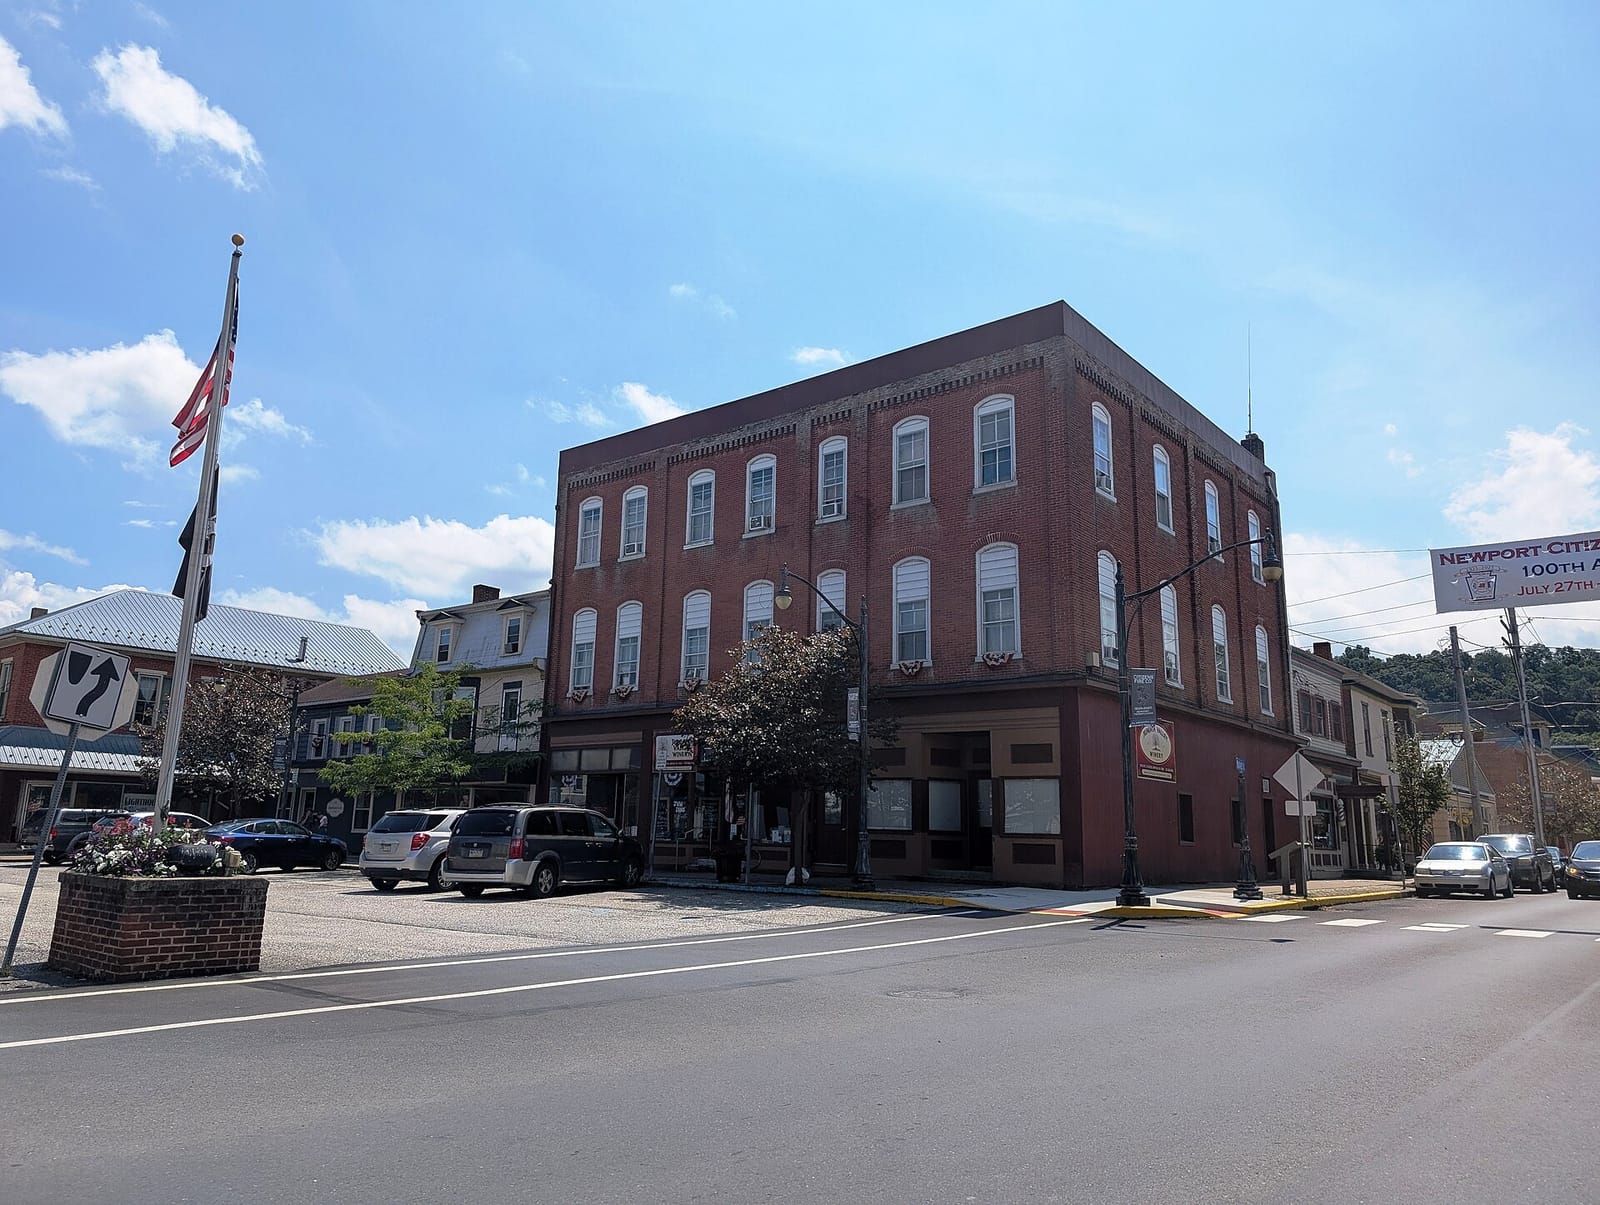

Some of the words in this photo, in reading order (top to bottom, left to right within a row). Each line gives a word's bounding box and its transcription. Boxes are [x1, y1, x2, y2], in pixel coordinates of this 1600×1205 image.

[1439, 546, 1542, 565] NEWPORT
[1522, 561, 1585, 577] 100TH
[1517, 584, 1550, 596] JULY
[1554, 580, 1593, 593] 27TH
